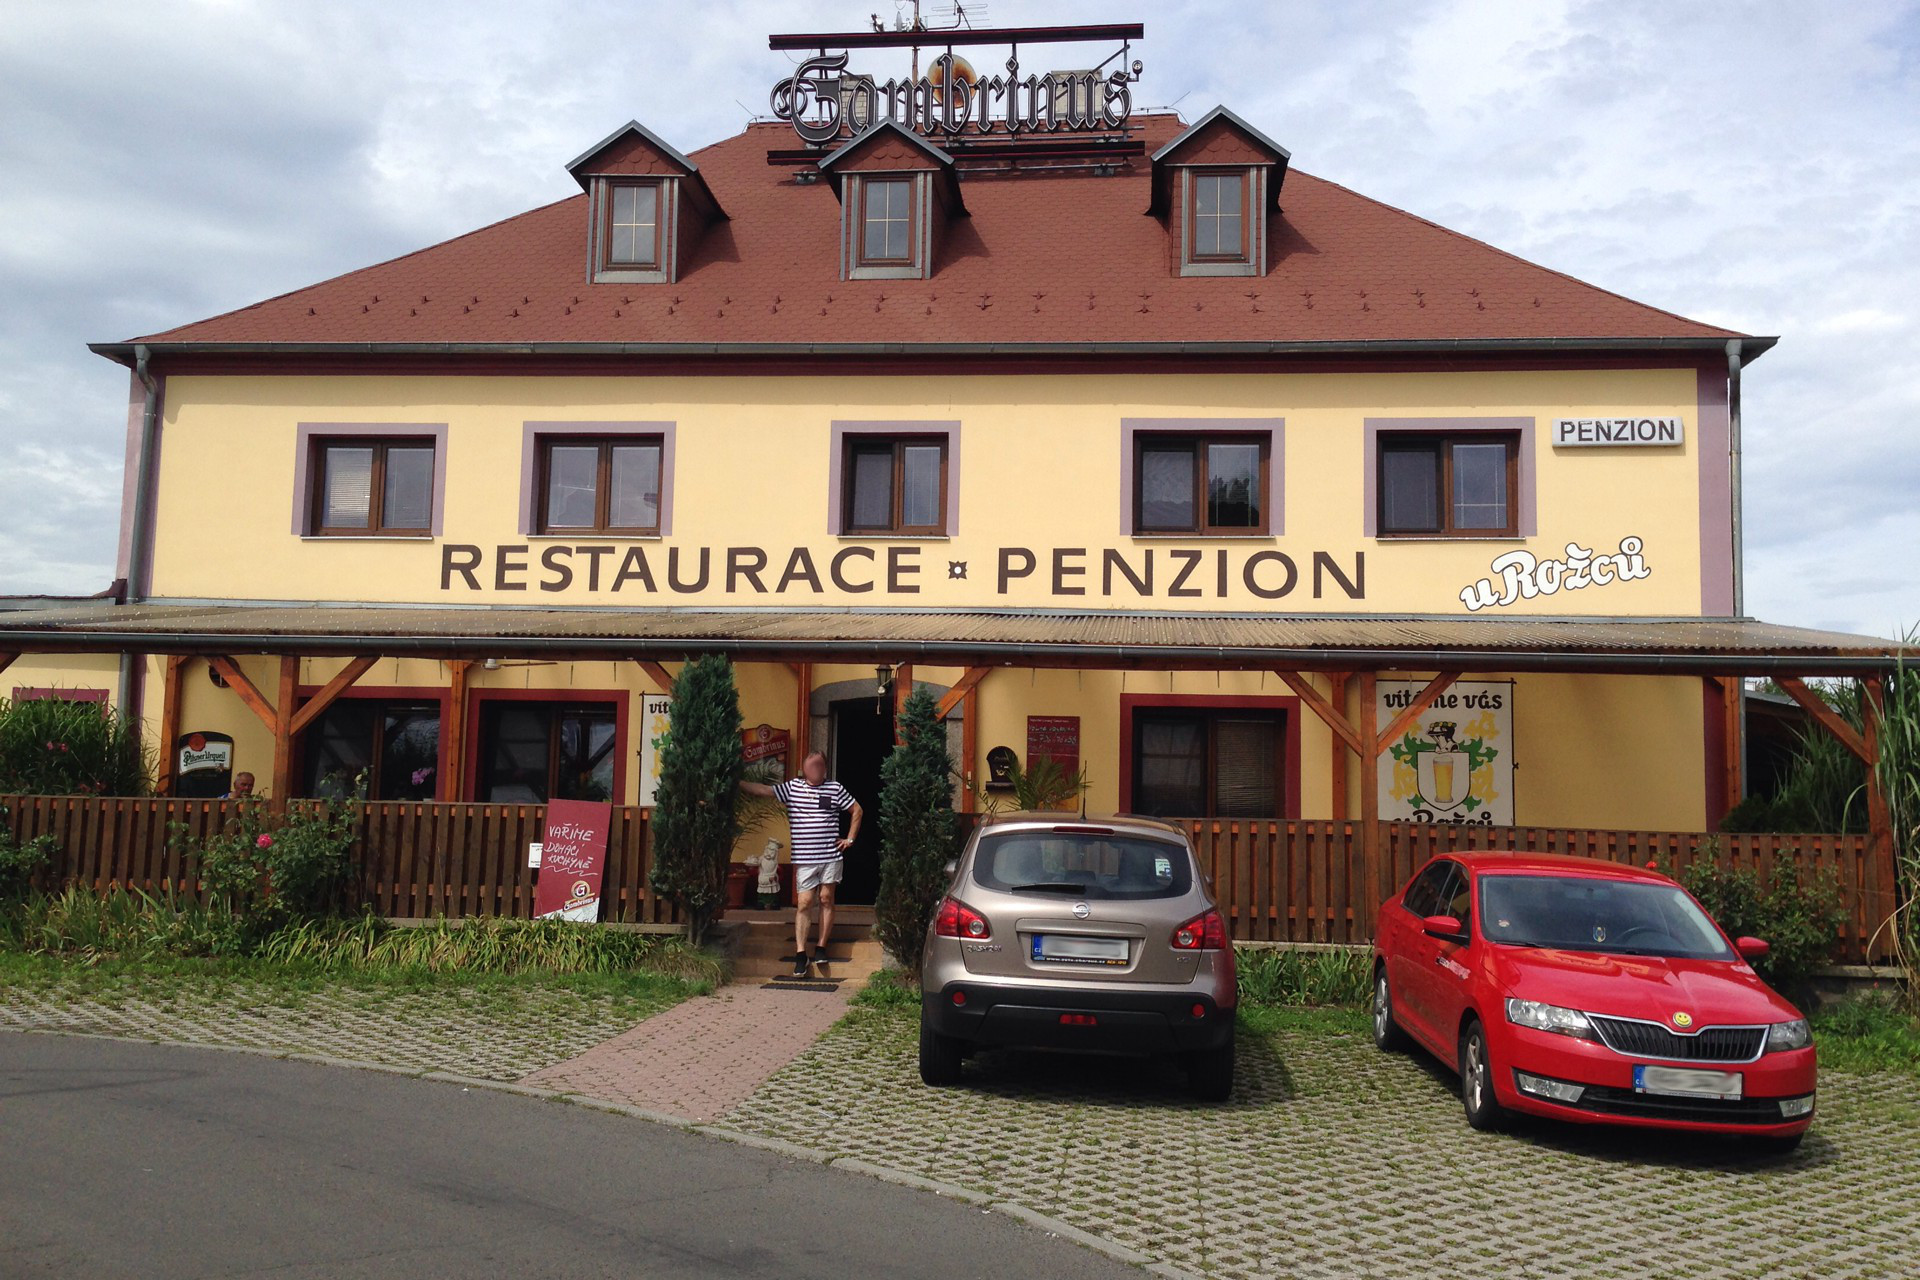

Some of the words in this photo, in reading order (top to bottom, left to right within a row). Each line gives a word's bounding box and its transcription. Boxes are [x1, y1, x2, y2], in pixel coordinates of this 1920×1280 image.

[769, 49, 1134, 144] Gambrinus
[1560, 419, 1675, 442] PENZION
[440, 543, 921, 594] RESTAURACE
[997, 547, 1366, 600] PENZION
[1462, 689, 1503, 710] vás
[205, 750, 226, 762] Urquell
[743, 740, 786, 758] Gambrinus
